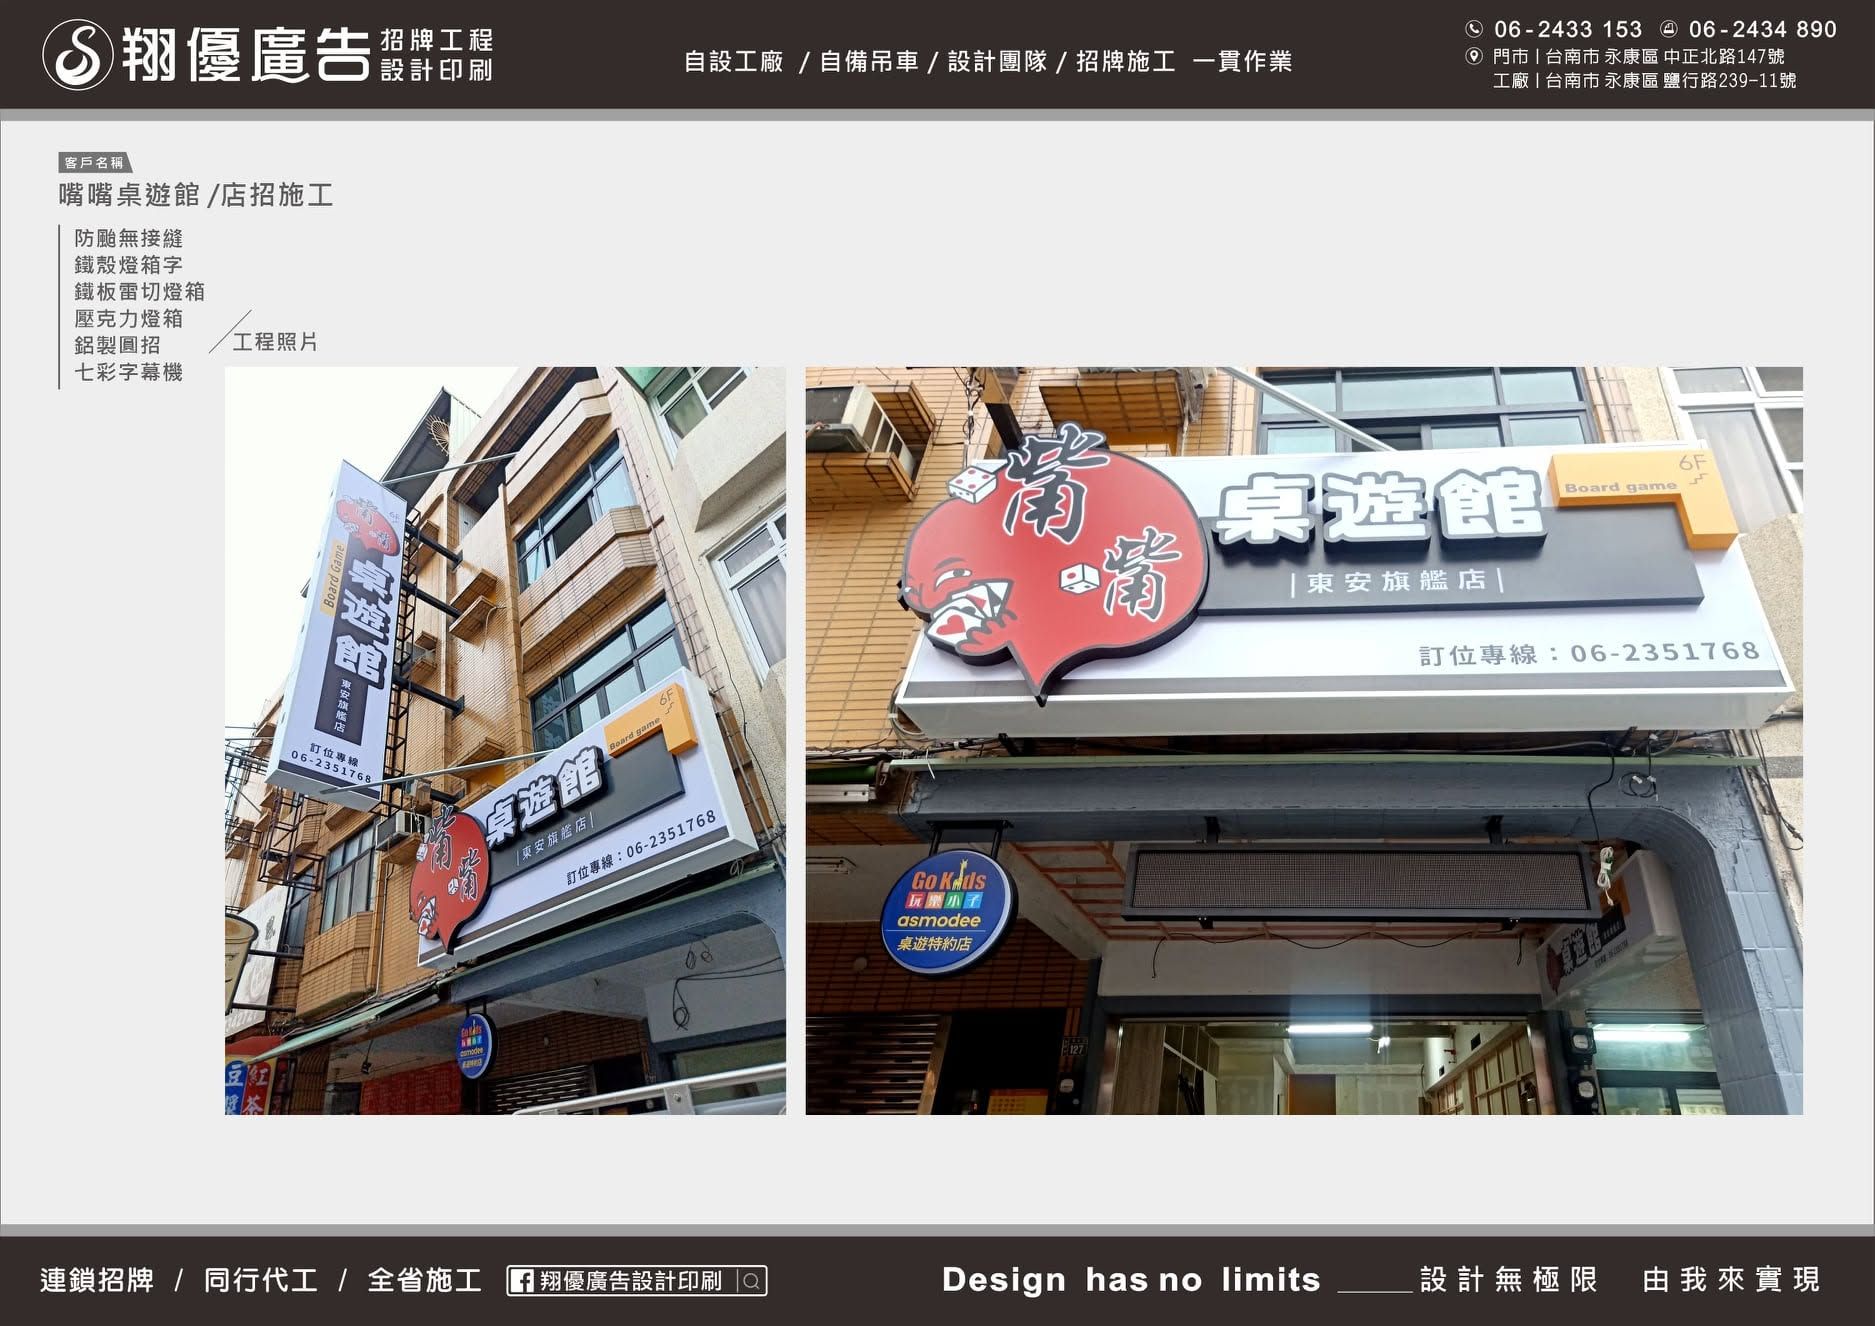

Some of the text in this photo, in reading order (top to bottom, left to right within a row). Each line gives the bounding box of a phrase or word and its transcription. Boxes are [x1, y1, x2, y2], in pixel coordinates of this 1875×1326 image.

[1678, 454, 1708, 472] 6F
[1564, 480, 1679, 495] Board game
[1213, 467, 1547, 547] 桌遊館
[324, 544, 345, 609] Board Game
[1307, 568, 1487, 594] 東安旗艦店
[333, 558, 394, 690] 桌遊館
[659, 688, 676, 706] 6F
[608, 717, 661, 752] Board game
[291, 750, 371, 784] 06-2351768
[310, 742, 360, 768] 訂位專線
[486, 745, 603, 848] 桌遊館
[522, 815, 588, 862] 東安旗艦店
[911, 871, 938, 891] Go
[906, 892, 983, 909] 玩樂小子
[897, 913, 982, 928] asmodee
[896, 936, 974, 952] 桌遊特約店
